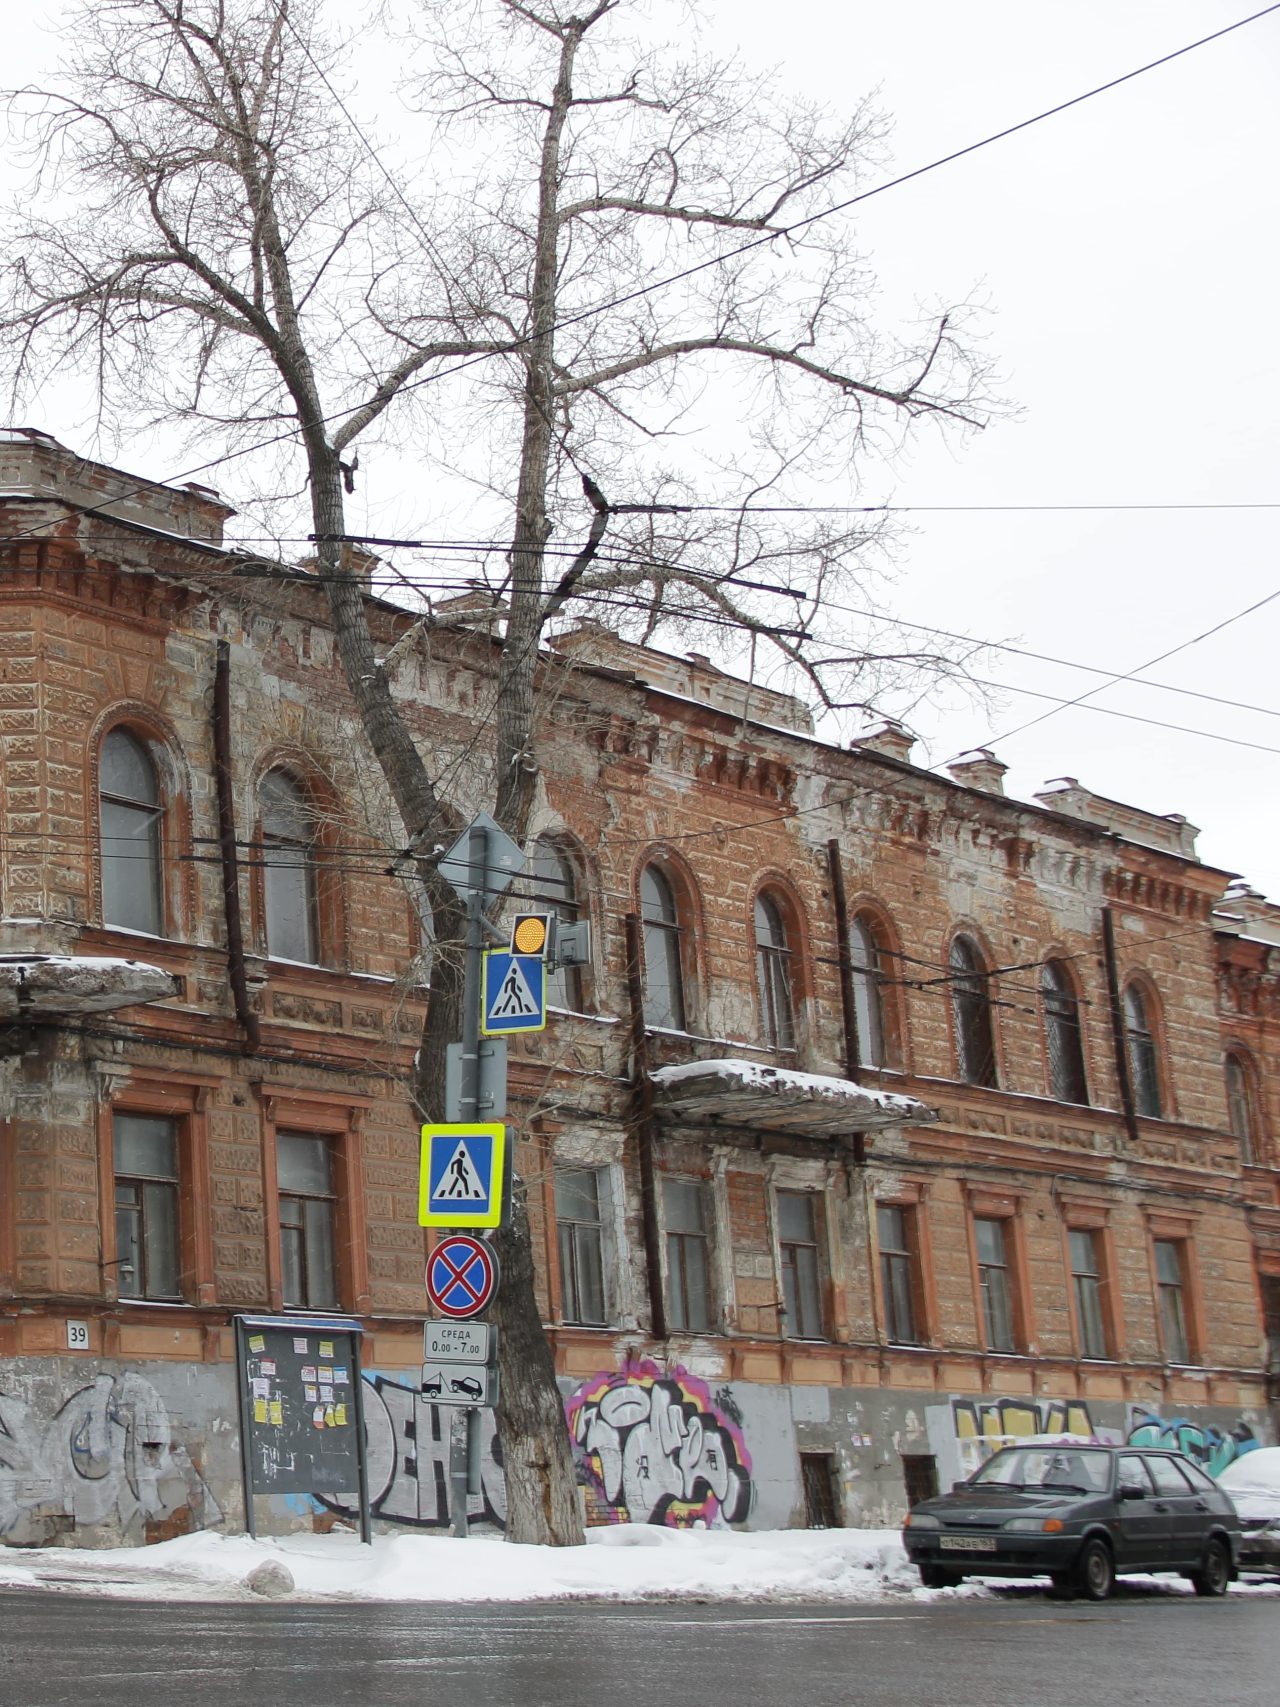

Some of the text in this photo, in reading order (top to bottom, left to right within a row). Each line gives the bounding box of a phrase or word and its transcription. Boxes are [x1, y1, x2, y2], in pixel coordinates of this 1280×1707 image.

[71, 1327, 86, 1342] 39
[441, 1330, 471, 1340] СРЕДА
[432, 1341, 451, 1352] 0.00
[461, 1342, 480, 1353] 7.00
